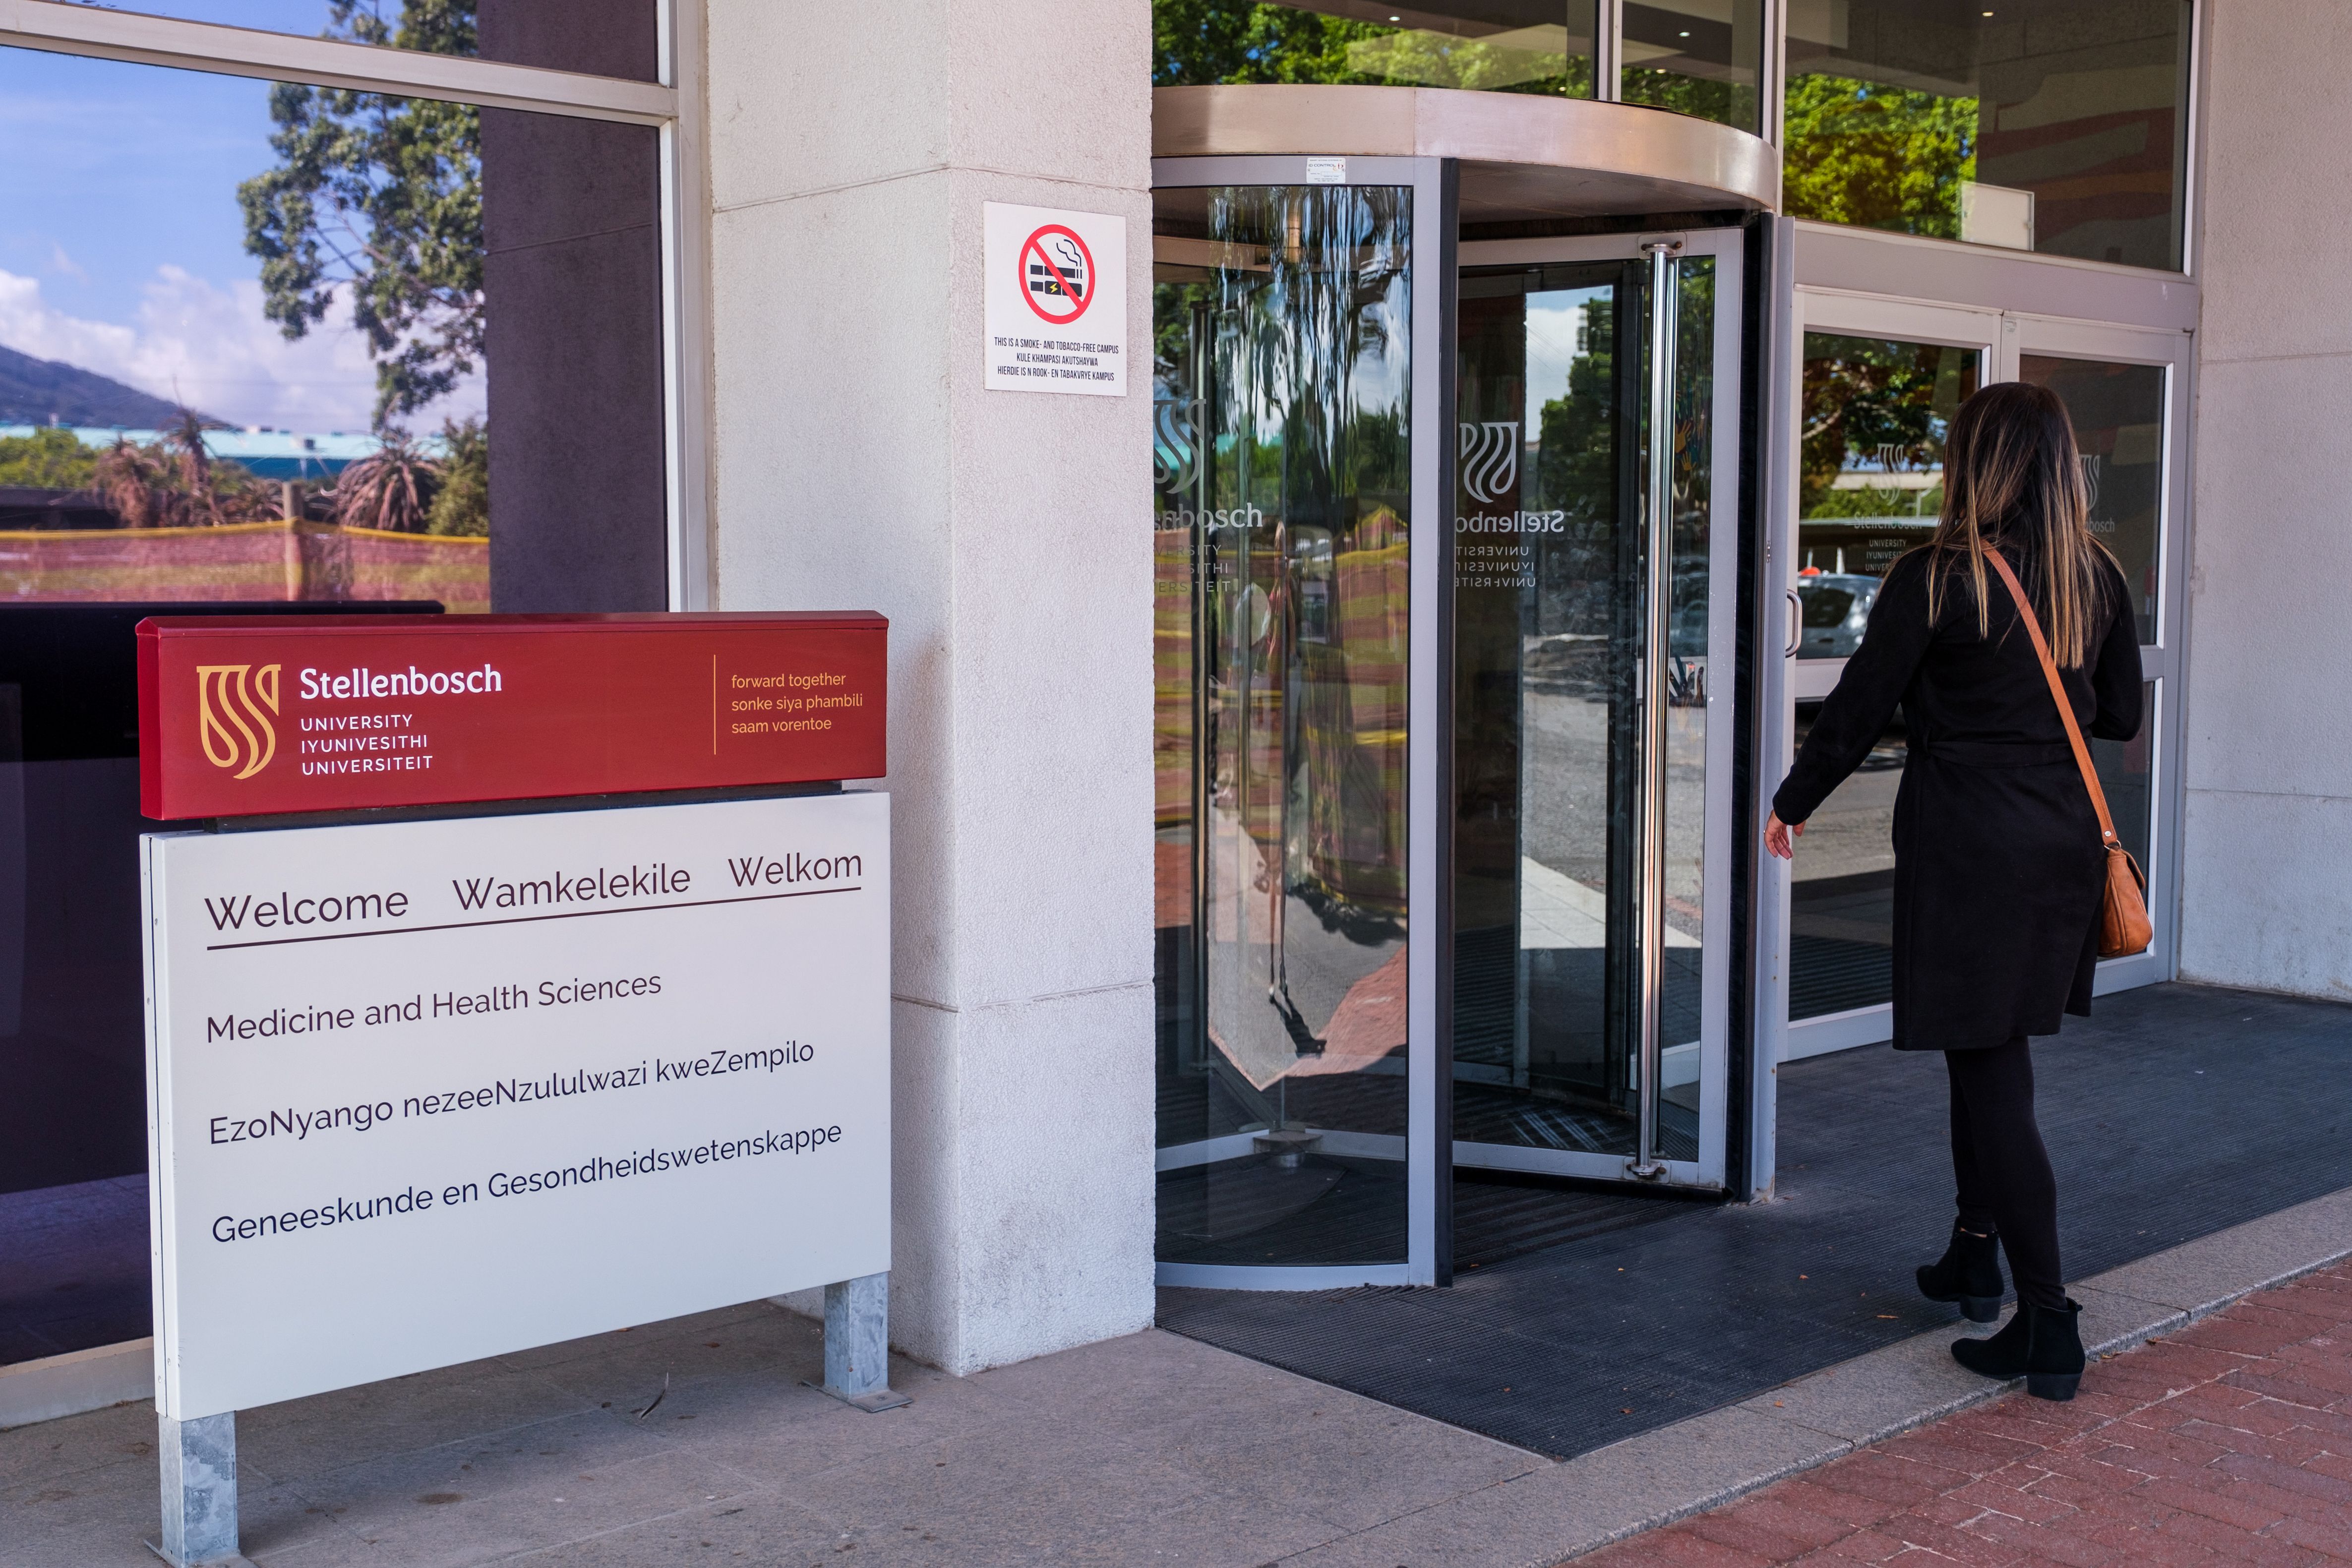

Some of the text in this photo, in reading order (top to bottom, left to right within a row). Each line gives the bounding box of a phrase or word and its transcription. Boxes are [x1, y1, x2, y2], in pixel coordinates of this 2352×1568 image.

[994, 337, 1119, 354] THIS IS A SMOKE- AND TOBACCO-FREE CAMPUS
[1017, 353, 1098, 366] KULE KHAMPASI AKUTSHAYWA
[998, 366, 1114, 381] HIERDIE IS N ROOK- EN TABAKVRYE KAMPUS
[2088, 516, 2115, 533] bosch
[1155, 544, 1221, 556] VERSITY
[1867, 551, 1902, 559] IYUNIVESIT
[300, 663, 502, 699] Stellenbosch
[731, 672, 846, 690] forward together
[731, 693, 863, 713] sonke siya phambili
[301, 714, 413, 731] UNIVERSITY
[731, 718, 832, 733] saam vorentoe
[302, 734, 427, 754] IYUNIVESITHI
[302, 755, 433, 776] UNIVERSITEIT
[204, 852, 861, 931] Welcome Wamkelekile Welkom
[207, 975, 662, 1043] Medicine and Health Sciences
[210, 1040, 814, 1144] EzoNyango nezeeNzululwazi kweZempilo
[212, 1125, 842, 1242] Geneeskunde en Gesondheidswetenskappe
